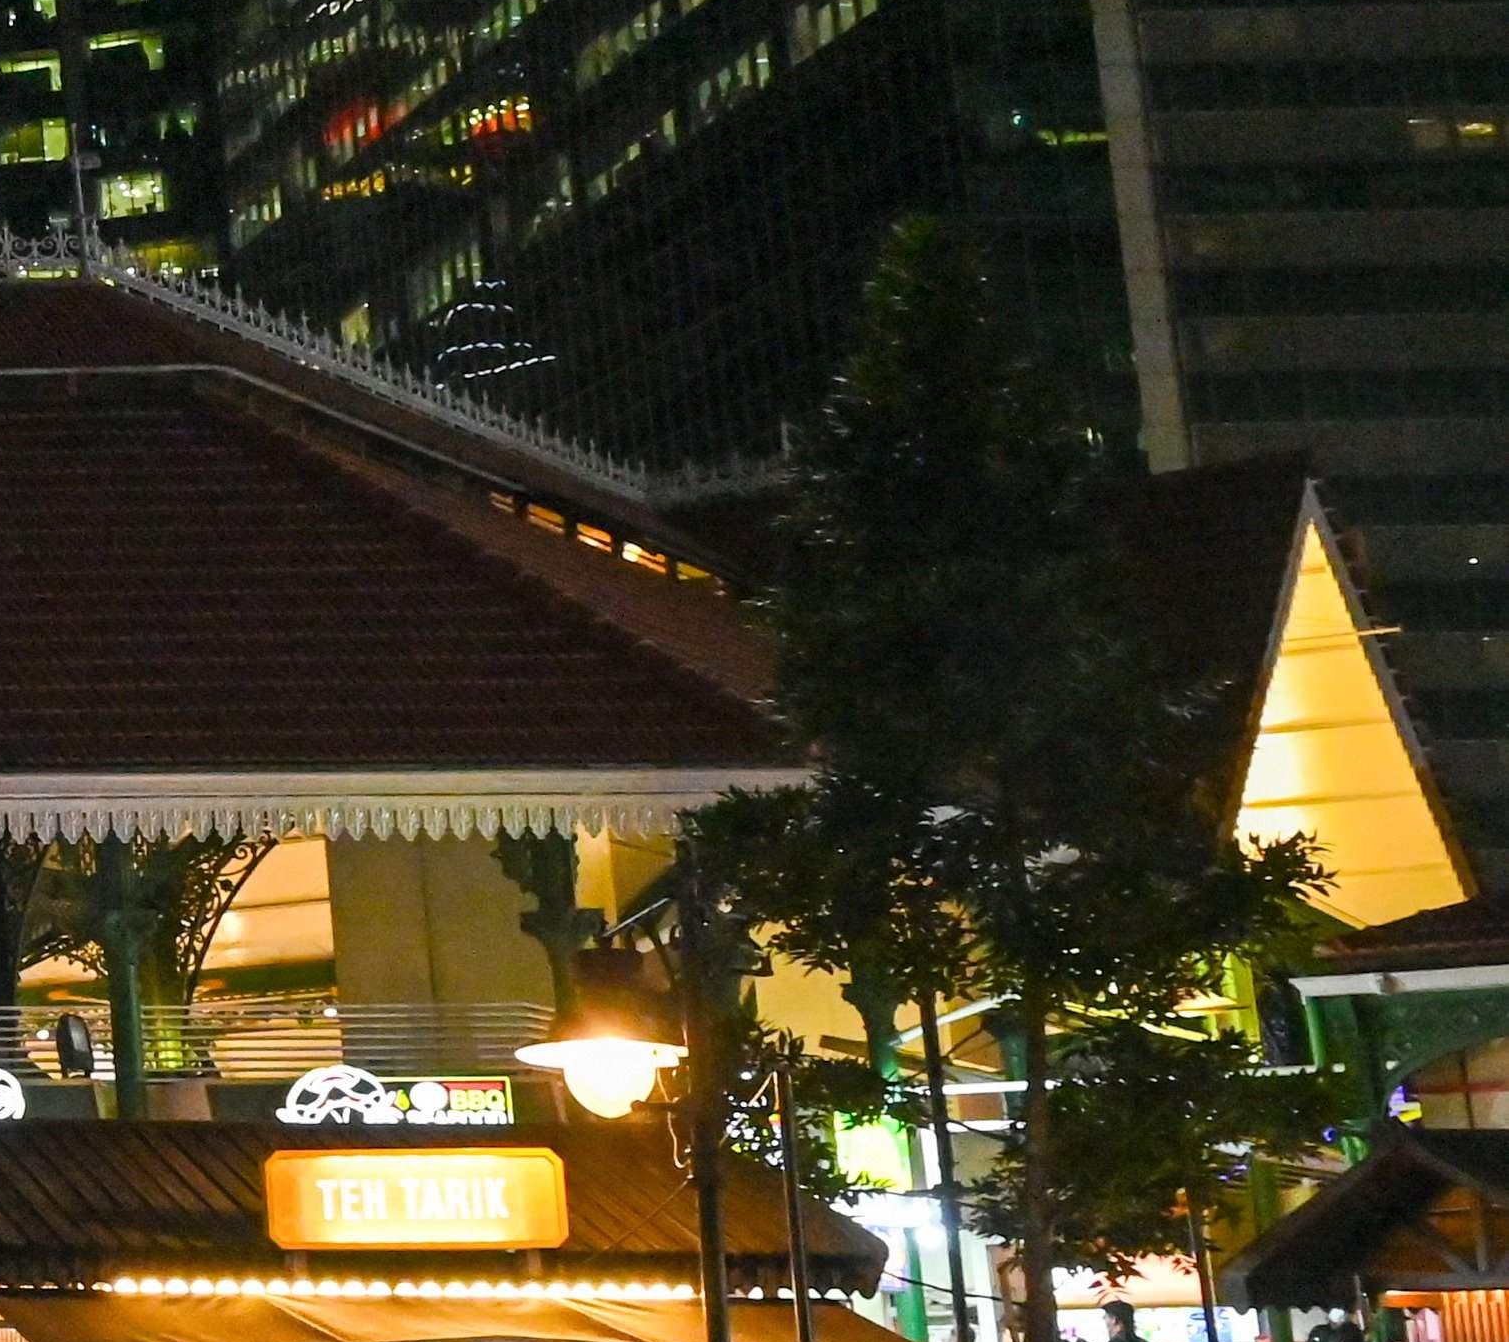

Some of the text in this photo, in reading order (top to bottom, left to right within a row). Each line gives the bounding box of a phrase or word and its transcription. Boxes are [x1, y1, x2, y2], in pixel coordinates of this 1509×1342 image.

[449, 1089, 506, 1110] BBQ
[315, 1177, 511, 1221] TEH TARIK
